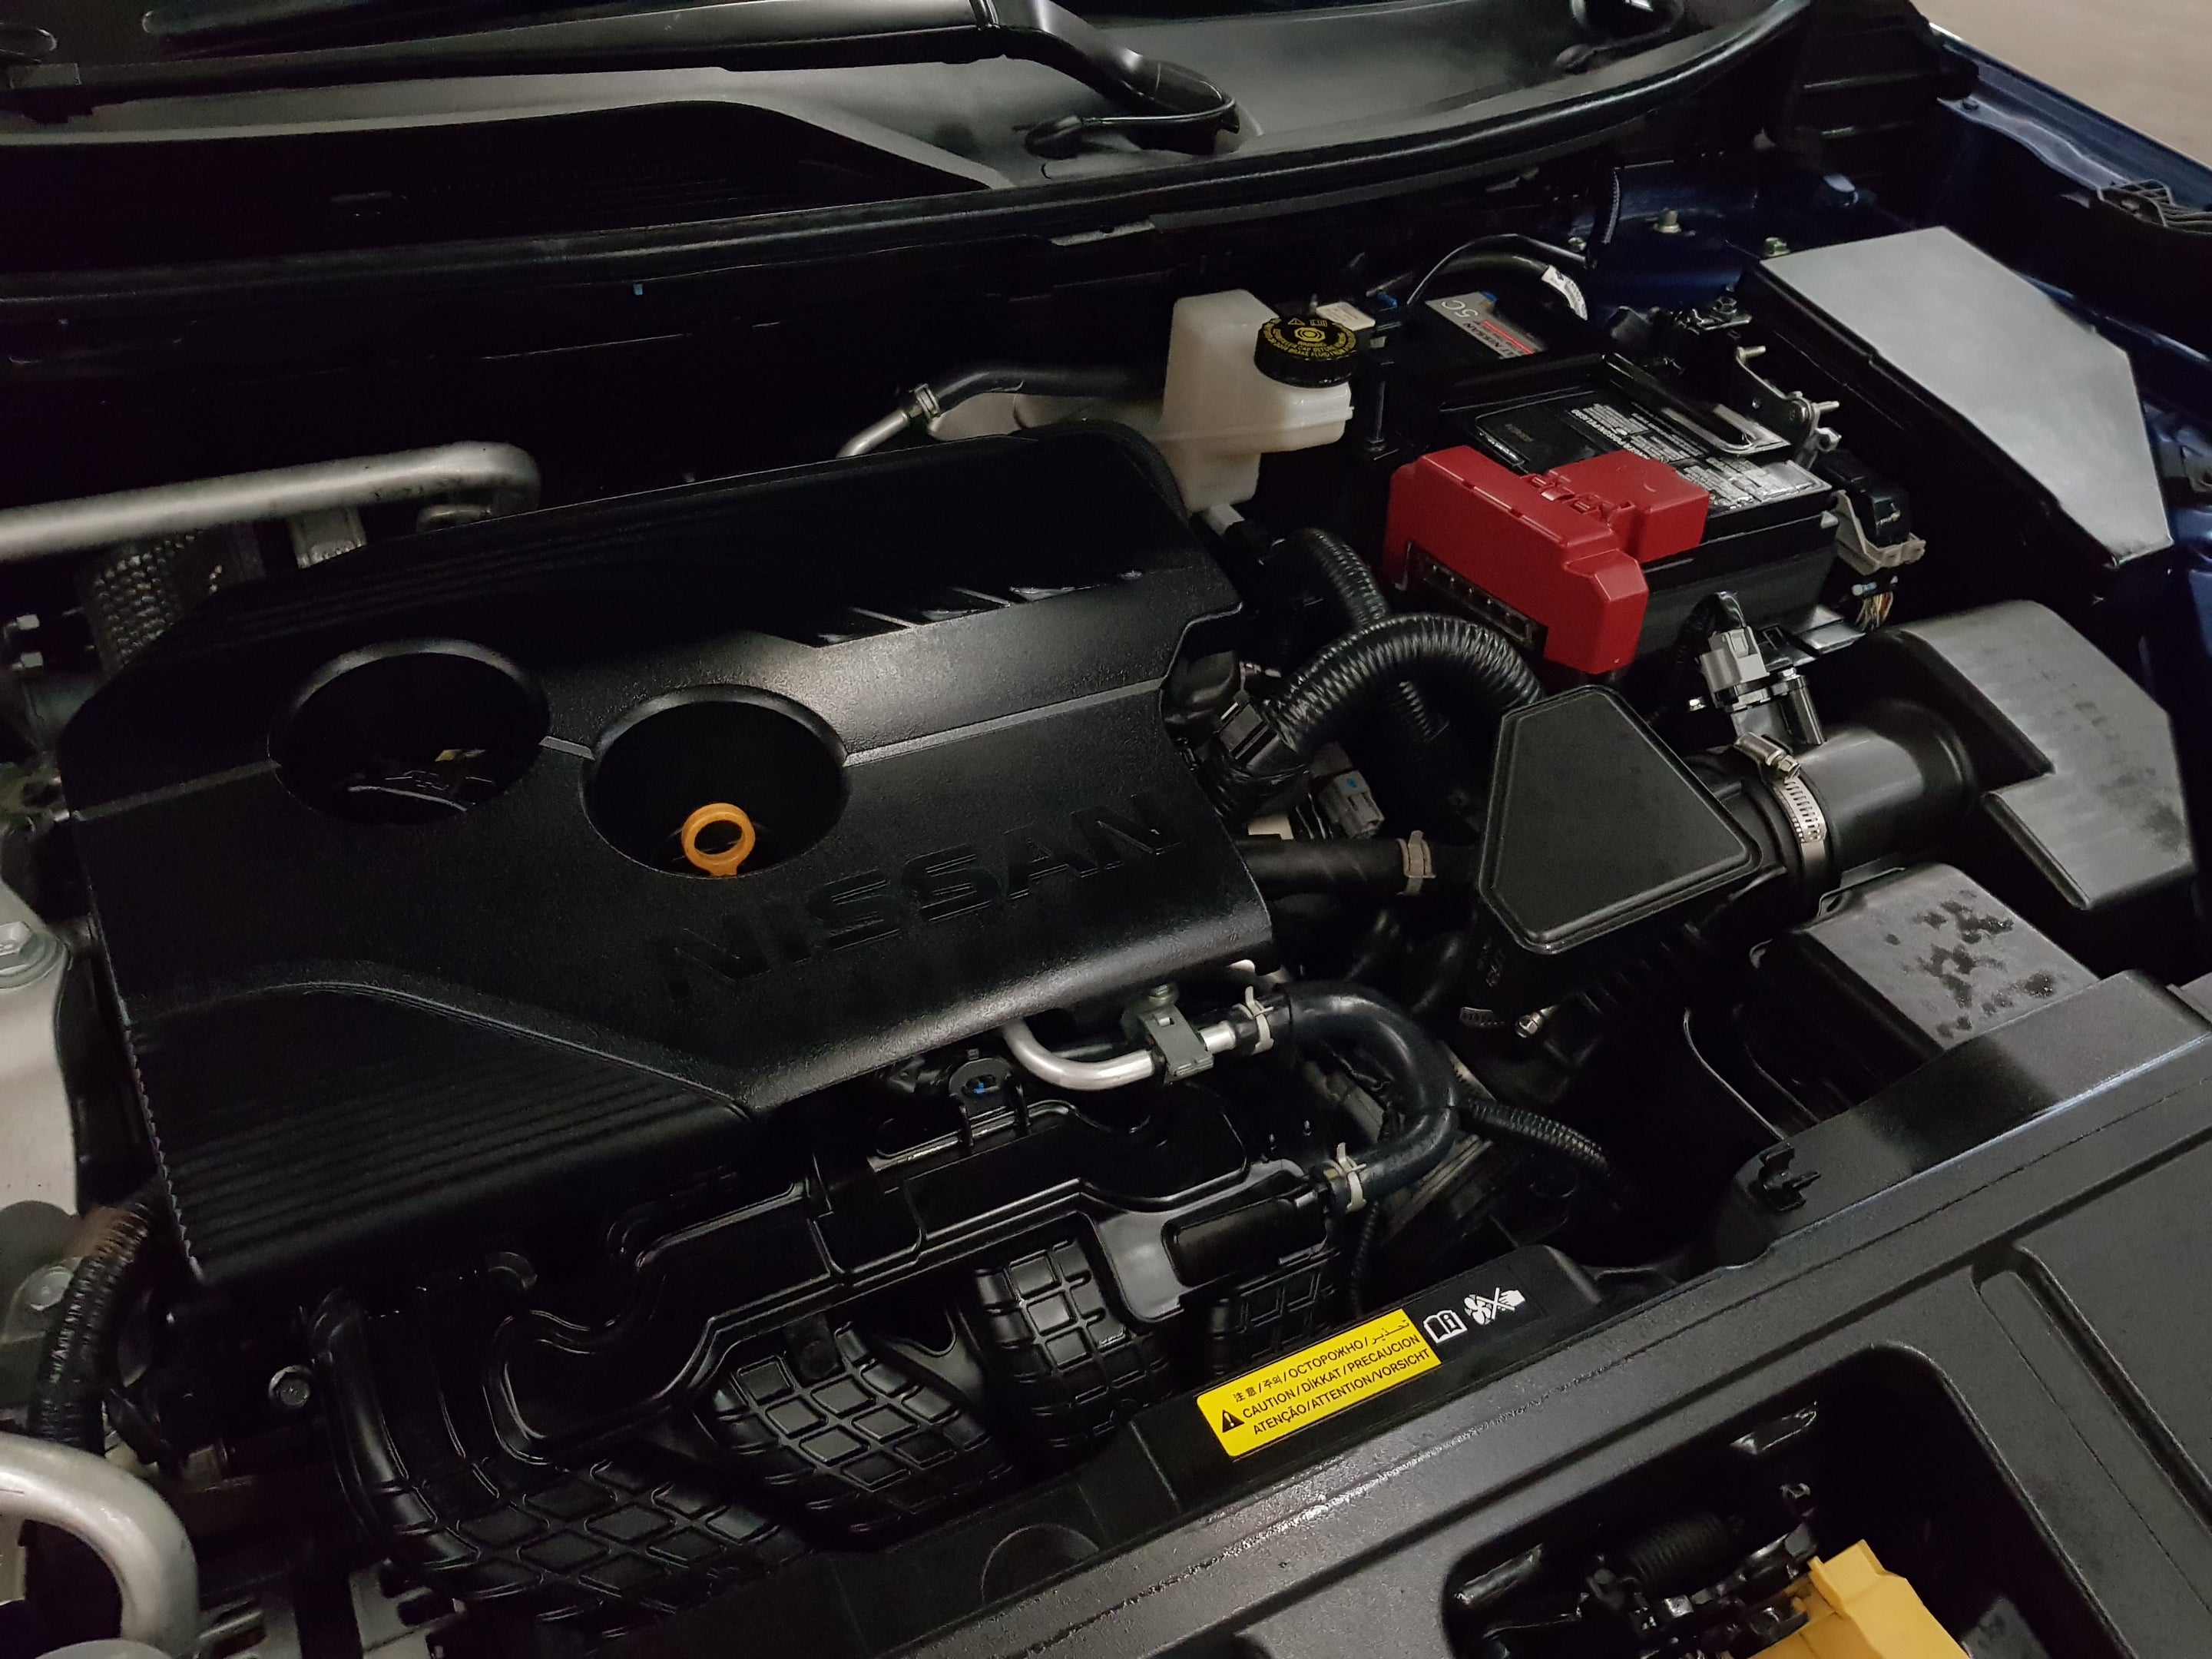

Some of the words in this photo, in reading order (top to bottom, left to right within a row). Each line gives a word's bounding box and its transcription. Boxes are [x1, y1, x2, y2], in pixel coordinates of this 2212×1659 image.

[648, 793, 1184, 1003] NISSAN
[1243, 1388, 1296, 1419] CAUTION
[1346, 1333, 1420, 1373] PRECAUCION
